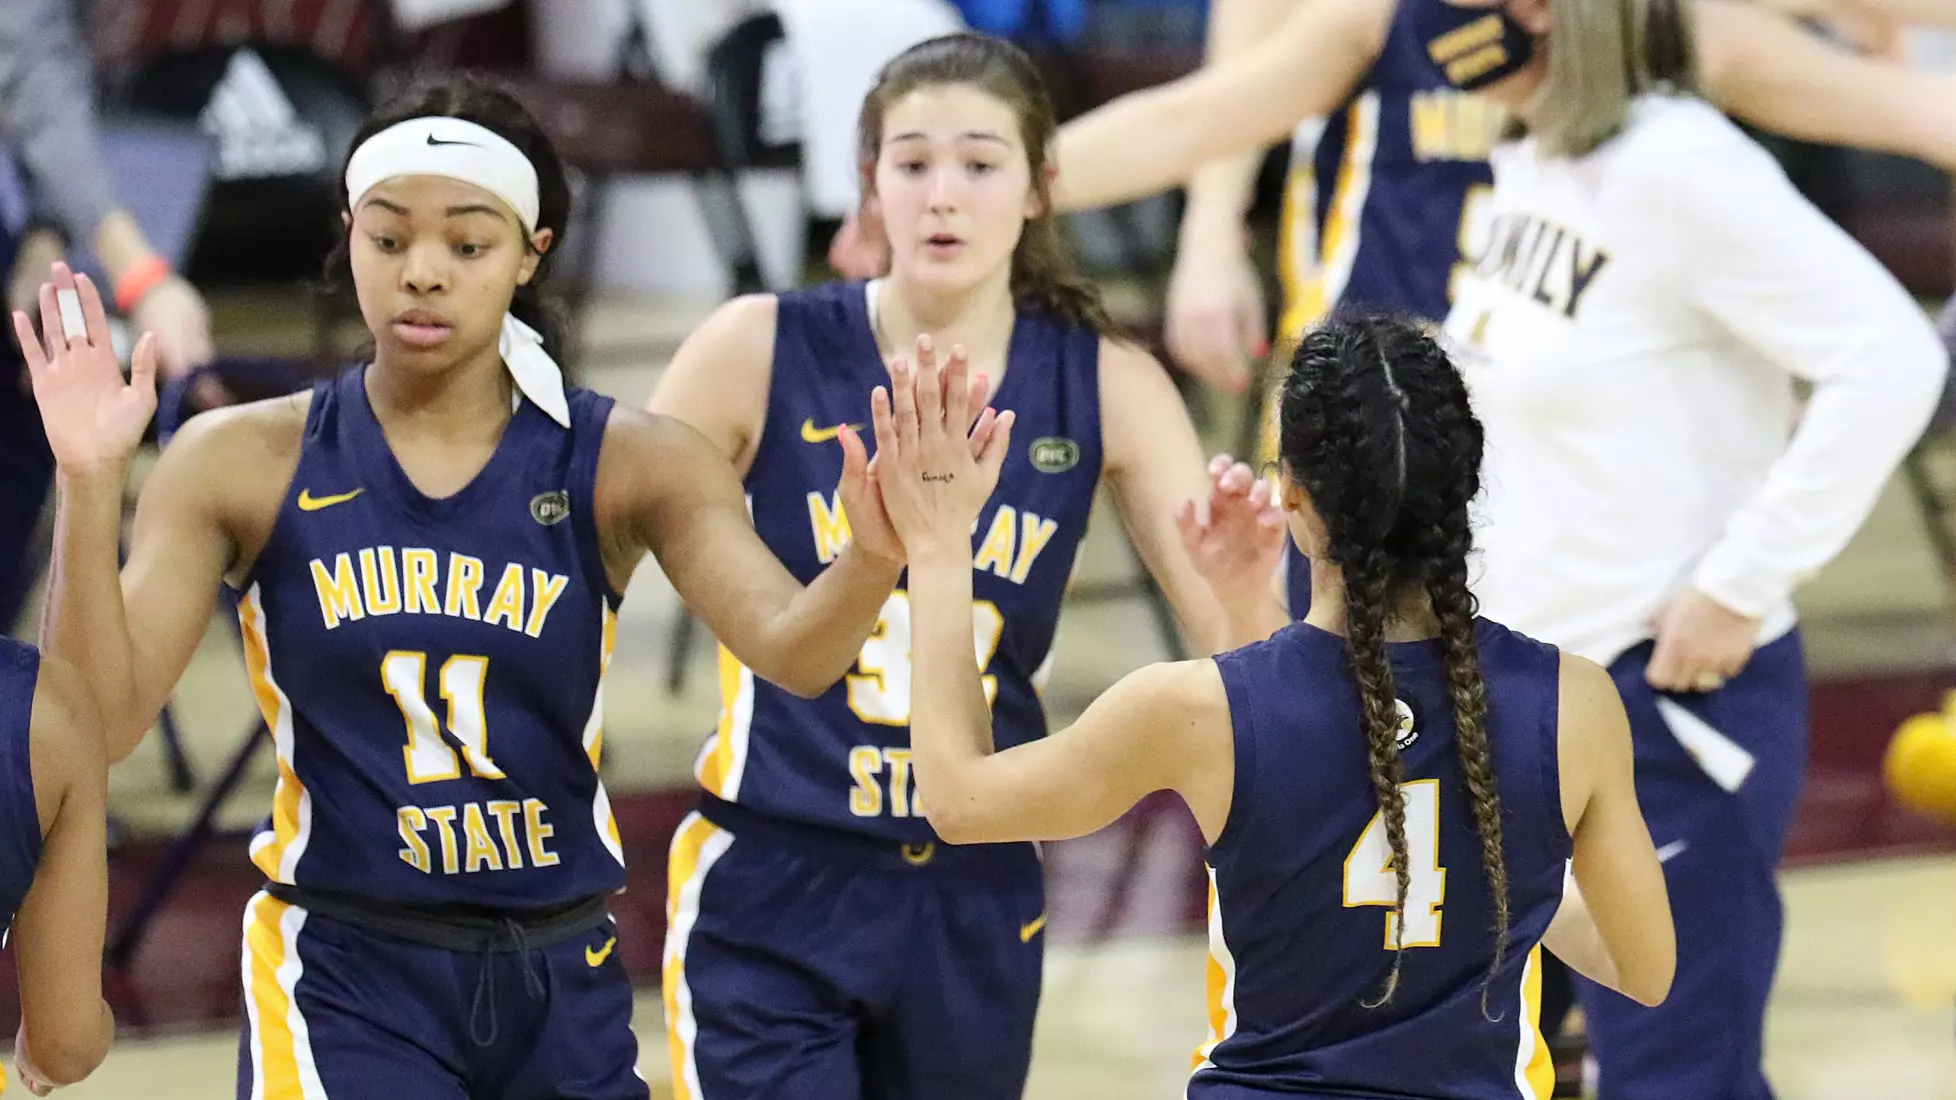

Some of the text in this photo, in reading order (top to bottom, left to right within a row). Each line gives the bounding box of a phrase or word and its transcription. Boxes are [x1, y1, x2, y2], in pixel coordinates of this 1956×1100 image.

[309, 546, 569, 638] MURRAY
[380, 650, 507, 785] 11
[397, 797, 561, 875] STATE
[1342, 778, 1447, 950] 4
